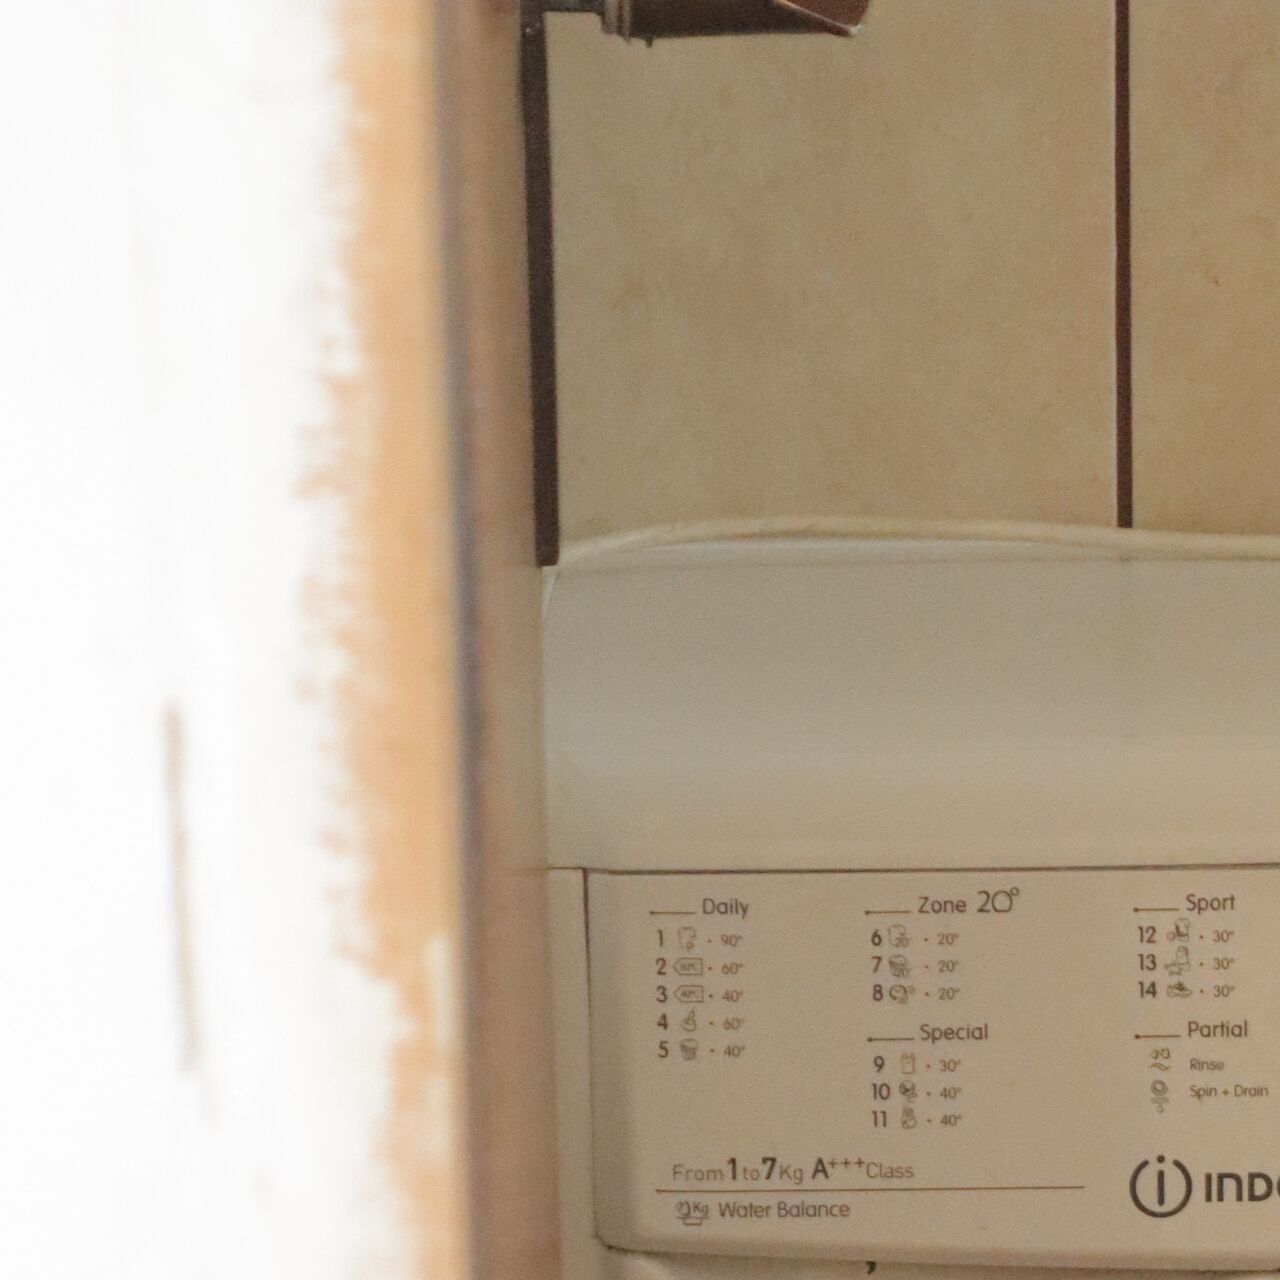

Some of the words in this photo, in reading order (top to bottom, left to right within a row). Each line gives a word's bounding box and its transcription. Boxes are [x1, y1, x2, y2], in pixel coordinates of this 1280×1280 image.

[702, 897, 750, 920] Daily
[917, 896, 967, 915] Zone
[1185, 893, 1236, 916] Sport
[656, 929, 665, 948] 1
[870, 929, 883, 947] 6
[1137, 925, 1158, 944] 12
[655, 957, 668, 976] 2
[870, 956, 883, 974] 7
[1137, 953, 1158, 972] 13
[655, 985, 668, 1003] 3
[871, 984, 884, 1002] 8
[1137, 980, 1158, 999] 14
[656, 1013, 669, 1032] 4
[1187, 1019, 1249, 1039] Partial
[919, 1023, 990, 1044] Special
[657, 1041, 669, 1059] 5
[873, 1055, 885, 1073] 9
[1189, 1057, 1225, 1072] Rinse
[870, 1082, 891, 1101] 10
[1189, 1084, 1218, 1102] Spin
[1233, 1084, 1270, 1099] Drain
[870, 1110, 888, 1129] 11
[672, 1164, 724, 1182] From
[727, 1157, 738, 1181] 1
[742, 1166, 760, 1182] to
[761, 1156, 777, 1181] 7
[779, 1163, 804, 1185] Kg
[866, 1162, 914, 1180] Class
[718, 1202, 772, 1218] Water
[777, 1200, 851, 1218] Balance
